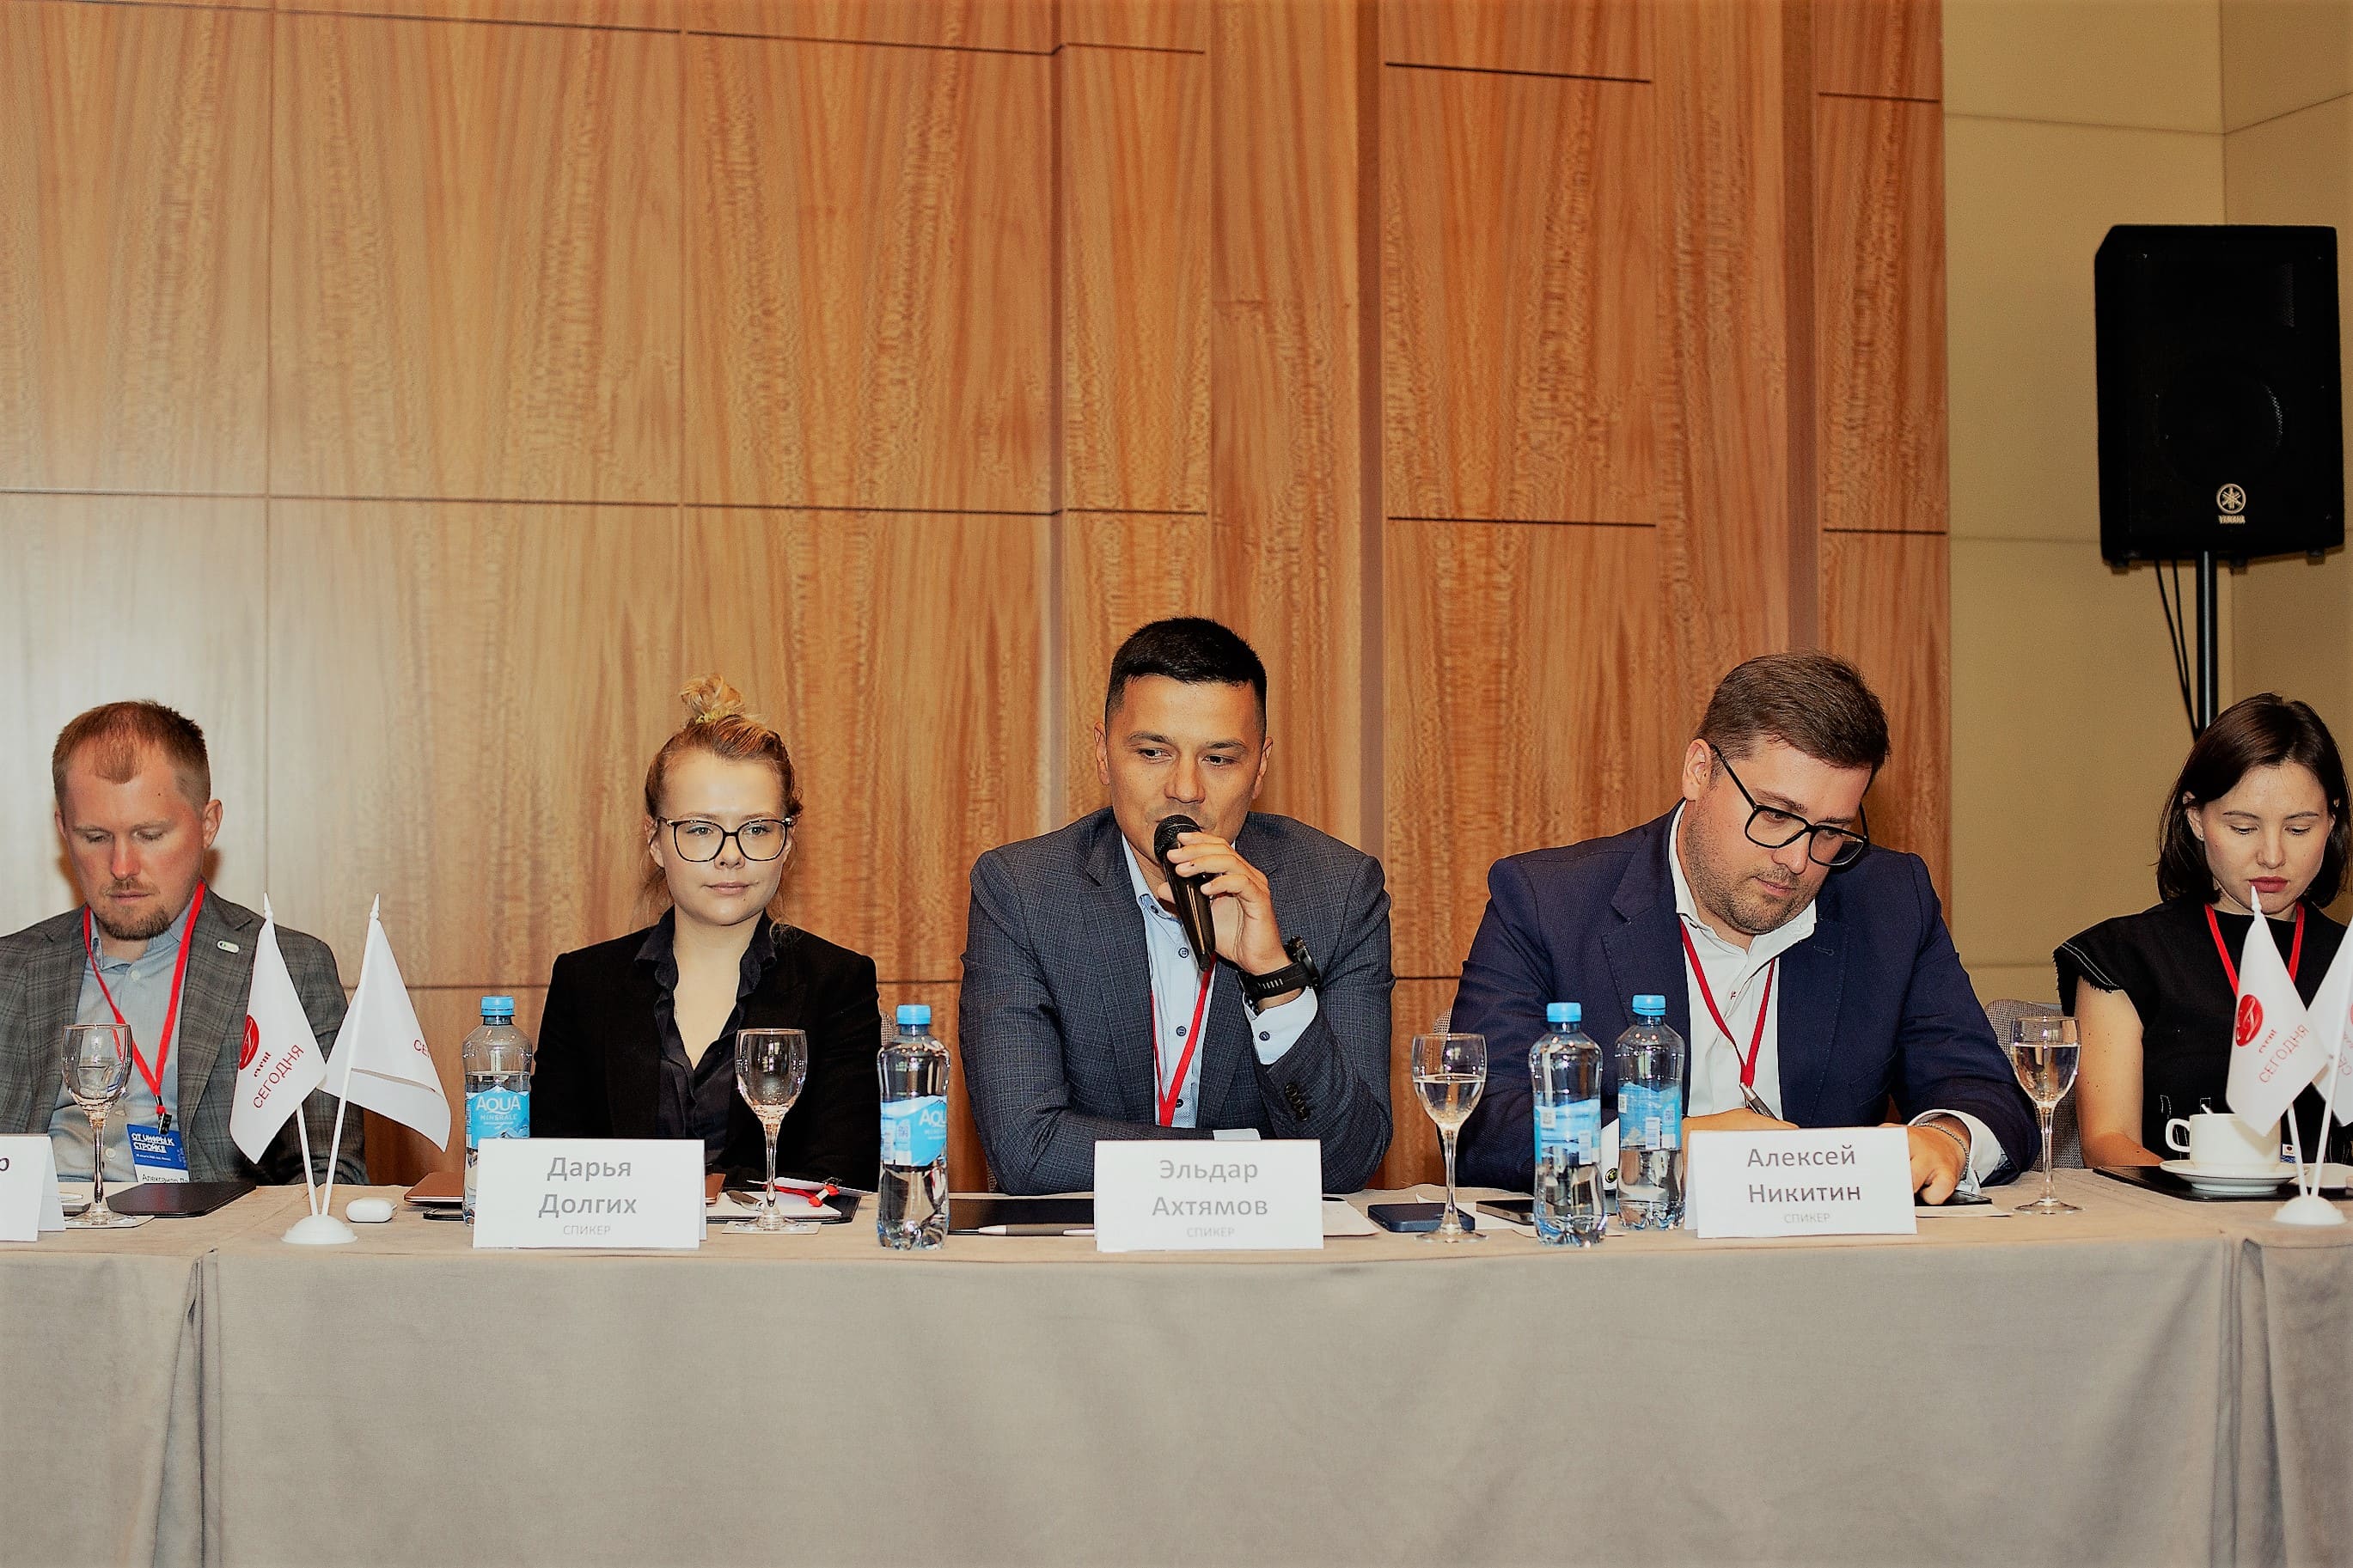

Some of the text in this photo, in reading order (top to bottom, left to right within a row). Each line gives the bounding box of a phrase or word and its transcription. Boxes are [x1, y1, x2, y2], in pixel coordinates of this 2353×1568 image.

[2218, 515, 2246, 524] YAMAHA
[2258, 1024, 2309, 1083] СЕГОДНЯ
[254, 1052, 272, 1077] event
[253, 1044, 304, 1108] СЕГОДНЯ
[475, 1095, 522, 1114] AQUA
[131, 1132, 142, 1141] ОТ
[1747, 1144, 1855, 1167] Алексей
[547, 1157, 632, 1181] Дарья
[1159, 1159, 1258, 1183] Эльдар
[1749, 1183, 1861, 1203] Никитин
[538, 1193, 637, 1218] Долгих
[1152, 1196, 1268, 1216] Ахтямов
[1783, 1212, 1830, 1223] СПИКЕР
[563, 1225, 611, 1235] СПИКЕР
[1186, 1226, 1235, 1238] СПИКЕР
